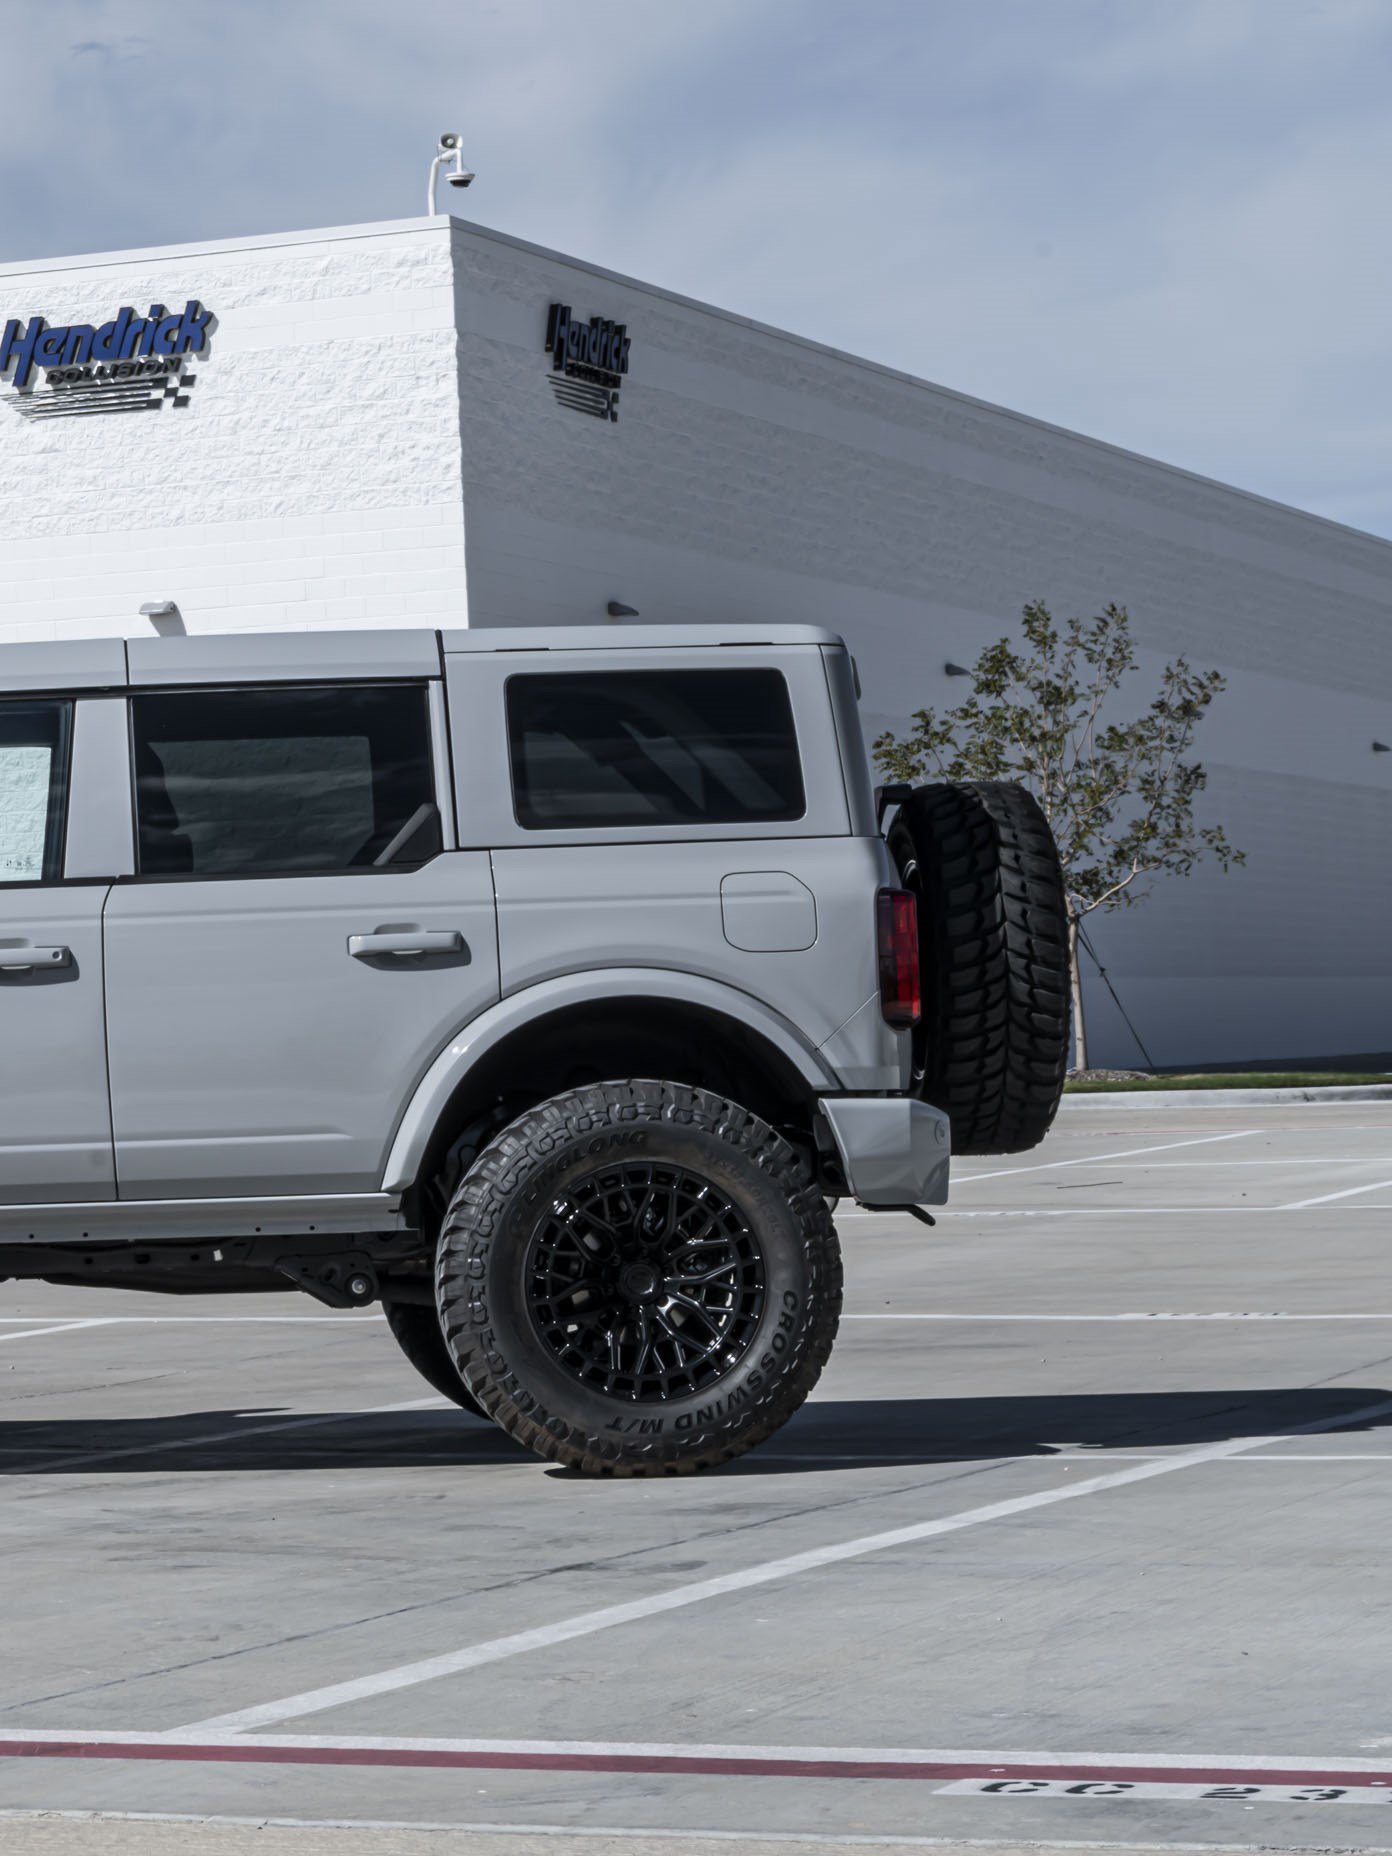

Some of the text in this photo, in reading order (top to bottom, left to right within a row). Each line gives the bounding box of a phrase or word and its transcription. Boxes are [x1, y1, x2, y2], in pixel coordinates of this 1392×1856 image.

[45, 357, 183, 384] COLLISION
[604, 1289, 798, 1434] CROSSWIND M/T
[981, 1781, 1392, 1802] CC 23
